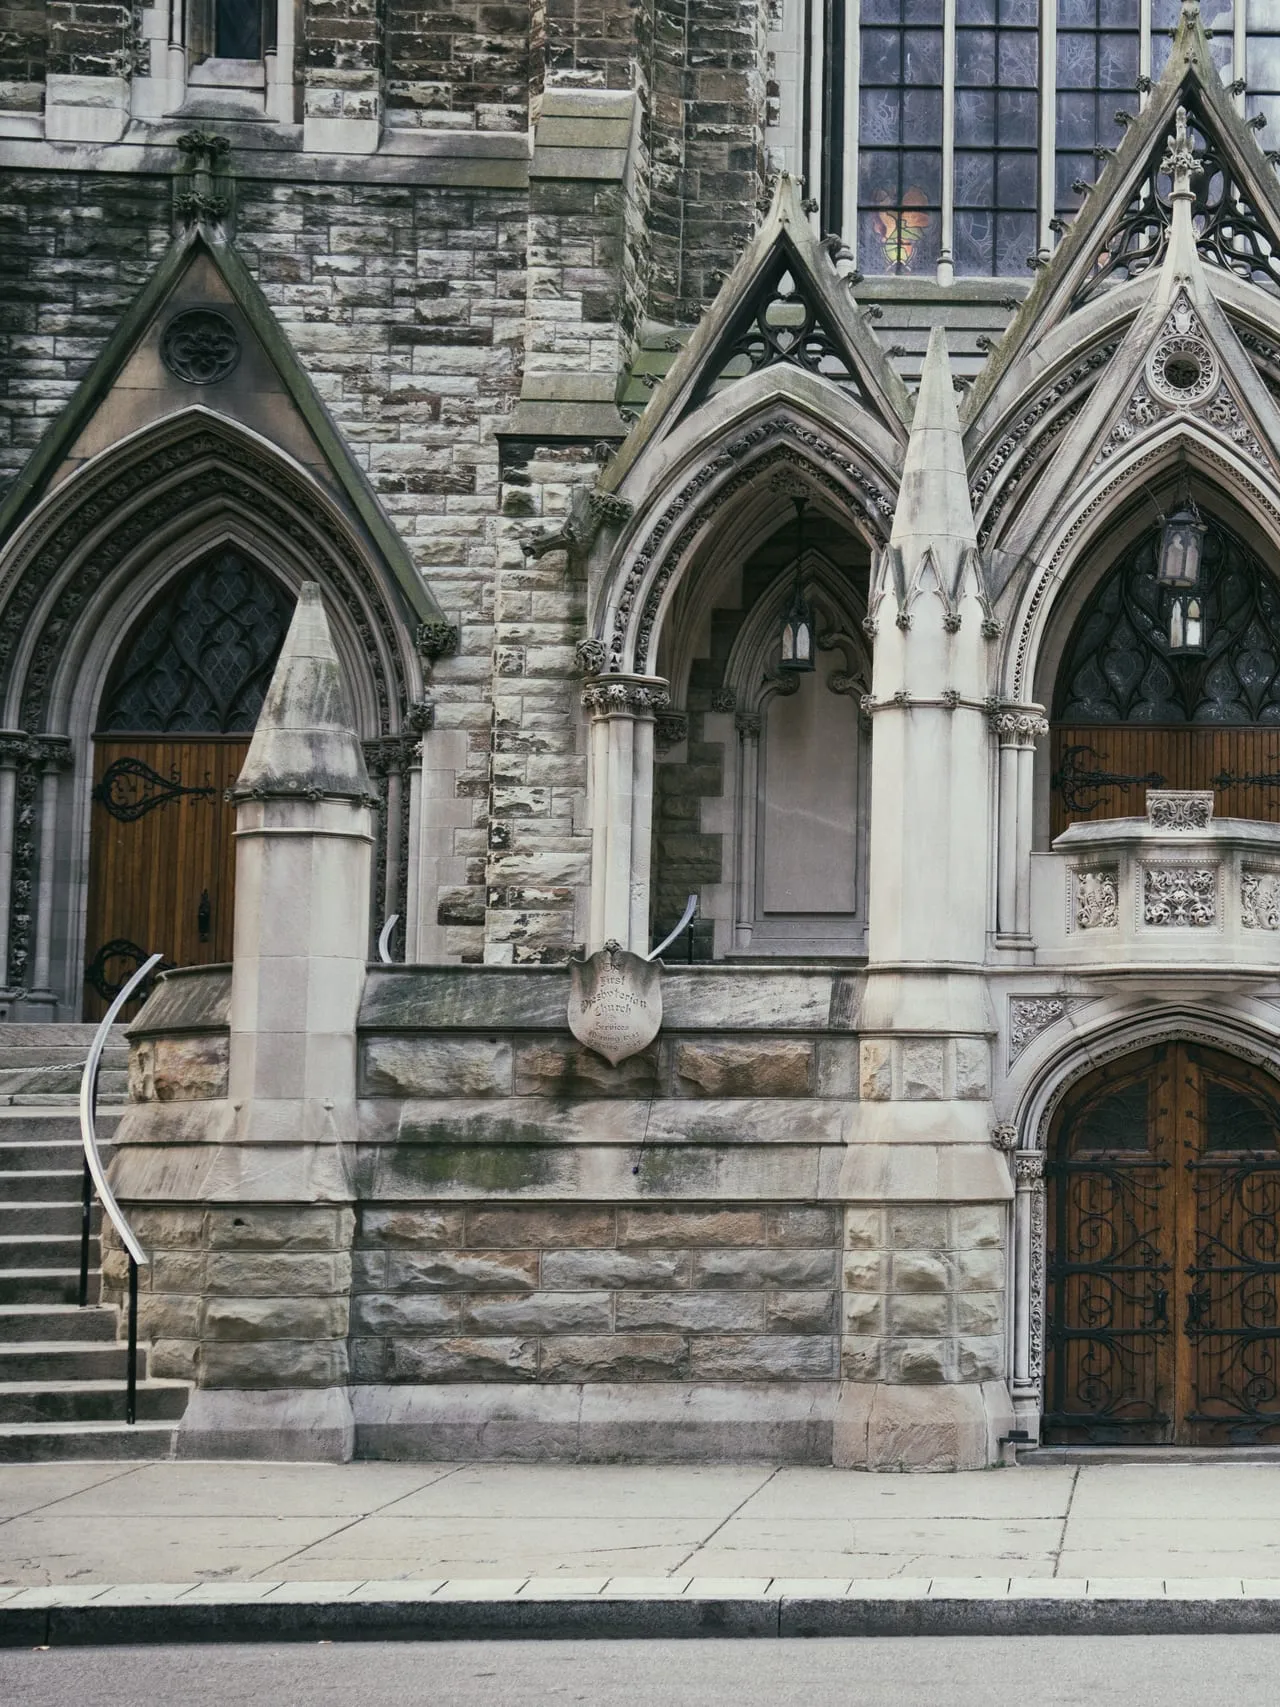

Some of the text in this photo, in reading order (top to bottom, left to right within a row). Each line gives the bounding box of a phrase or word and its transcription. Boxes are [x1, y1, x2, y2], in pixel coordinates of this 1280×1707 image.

[602, 962, 622, 972] The
[600, 975, 625, 987] First
[580, 988, 647, 1014] Presbyterian
[594, 1003, 632, 1017] Church
[595, 1022, 629, 1031] Services
